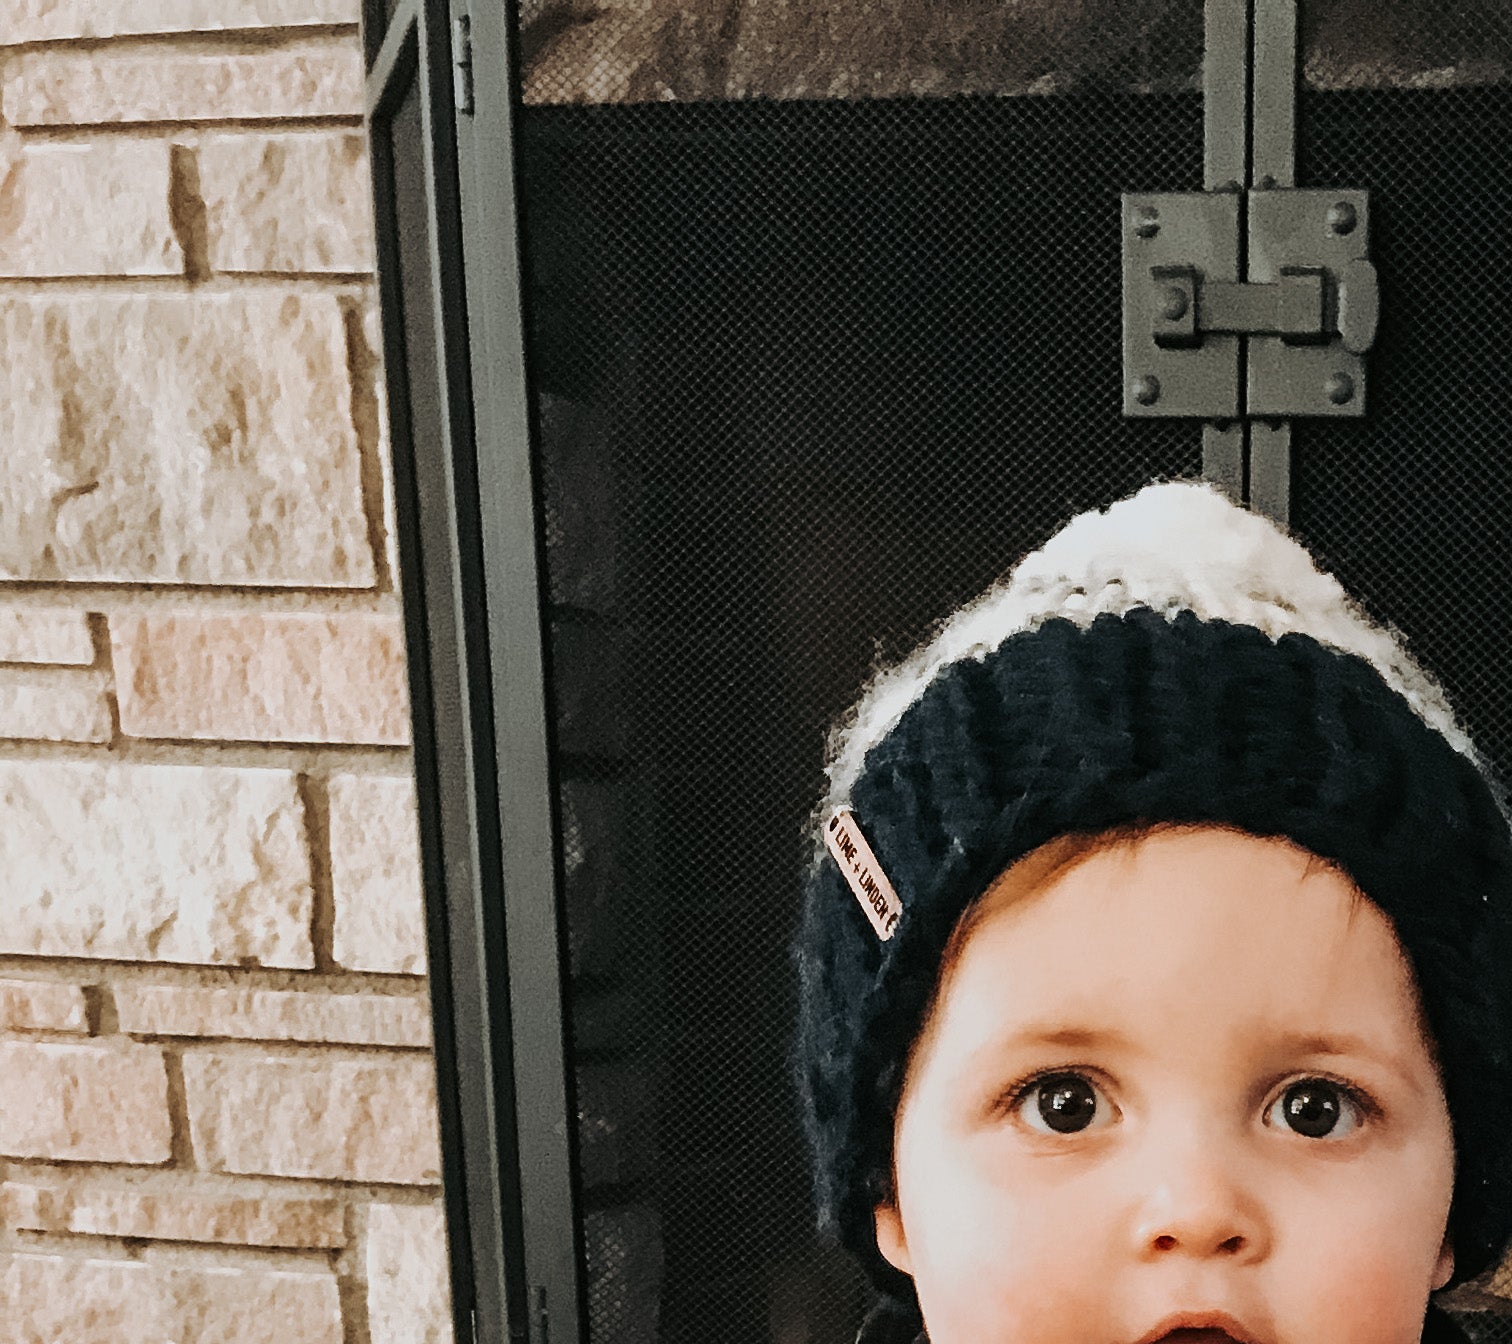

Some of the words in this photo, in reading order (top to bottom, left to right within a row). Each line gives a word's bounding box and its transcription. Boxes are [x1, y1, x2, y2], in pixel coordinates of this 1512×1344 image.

[835, 826, 858, 864] LIME
[853, 862, 861, 874] +
[858, 867, 889, 920] LINDEN
